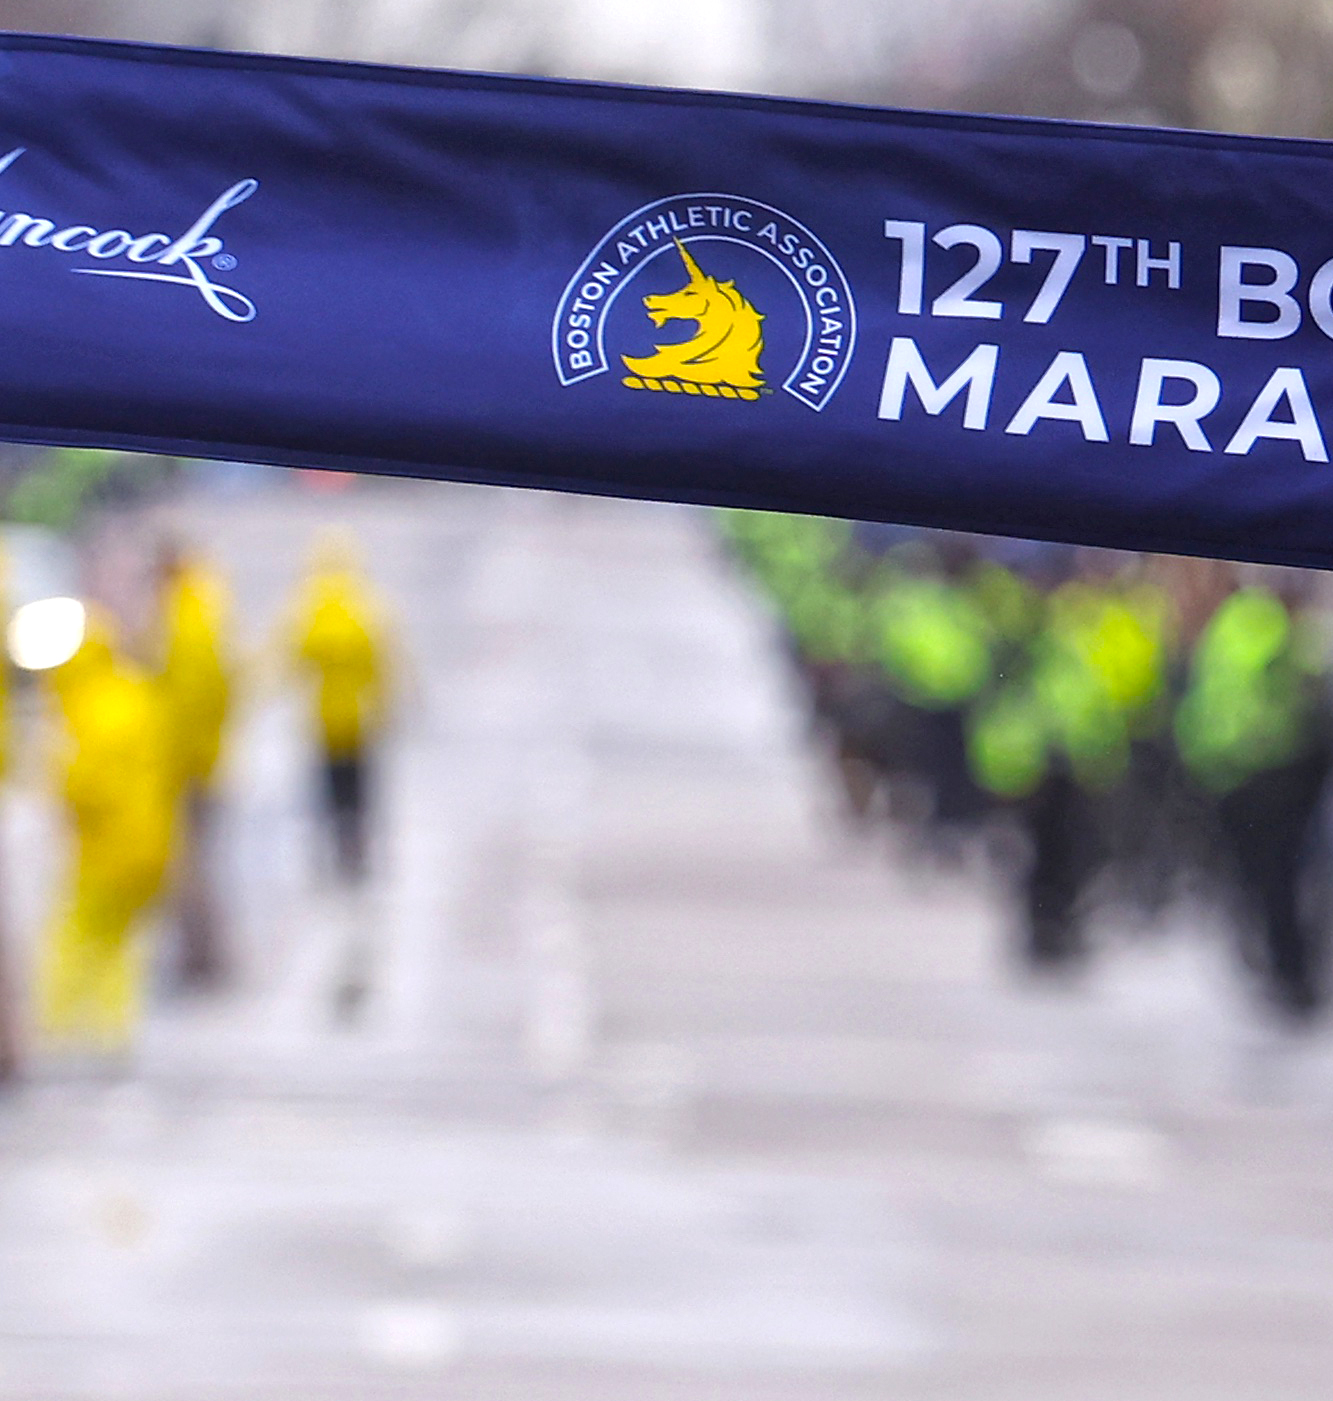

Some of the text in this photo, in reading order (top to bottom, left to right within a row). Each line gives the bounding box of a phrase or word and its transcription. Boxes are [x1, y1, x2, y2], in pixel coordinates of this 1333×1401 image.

[566, 206, 843, 395] BOSTON ATHLETIC ASSOCIATION
[884, 219, 1183, 324] 127TH
